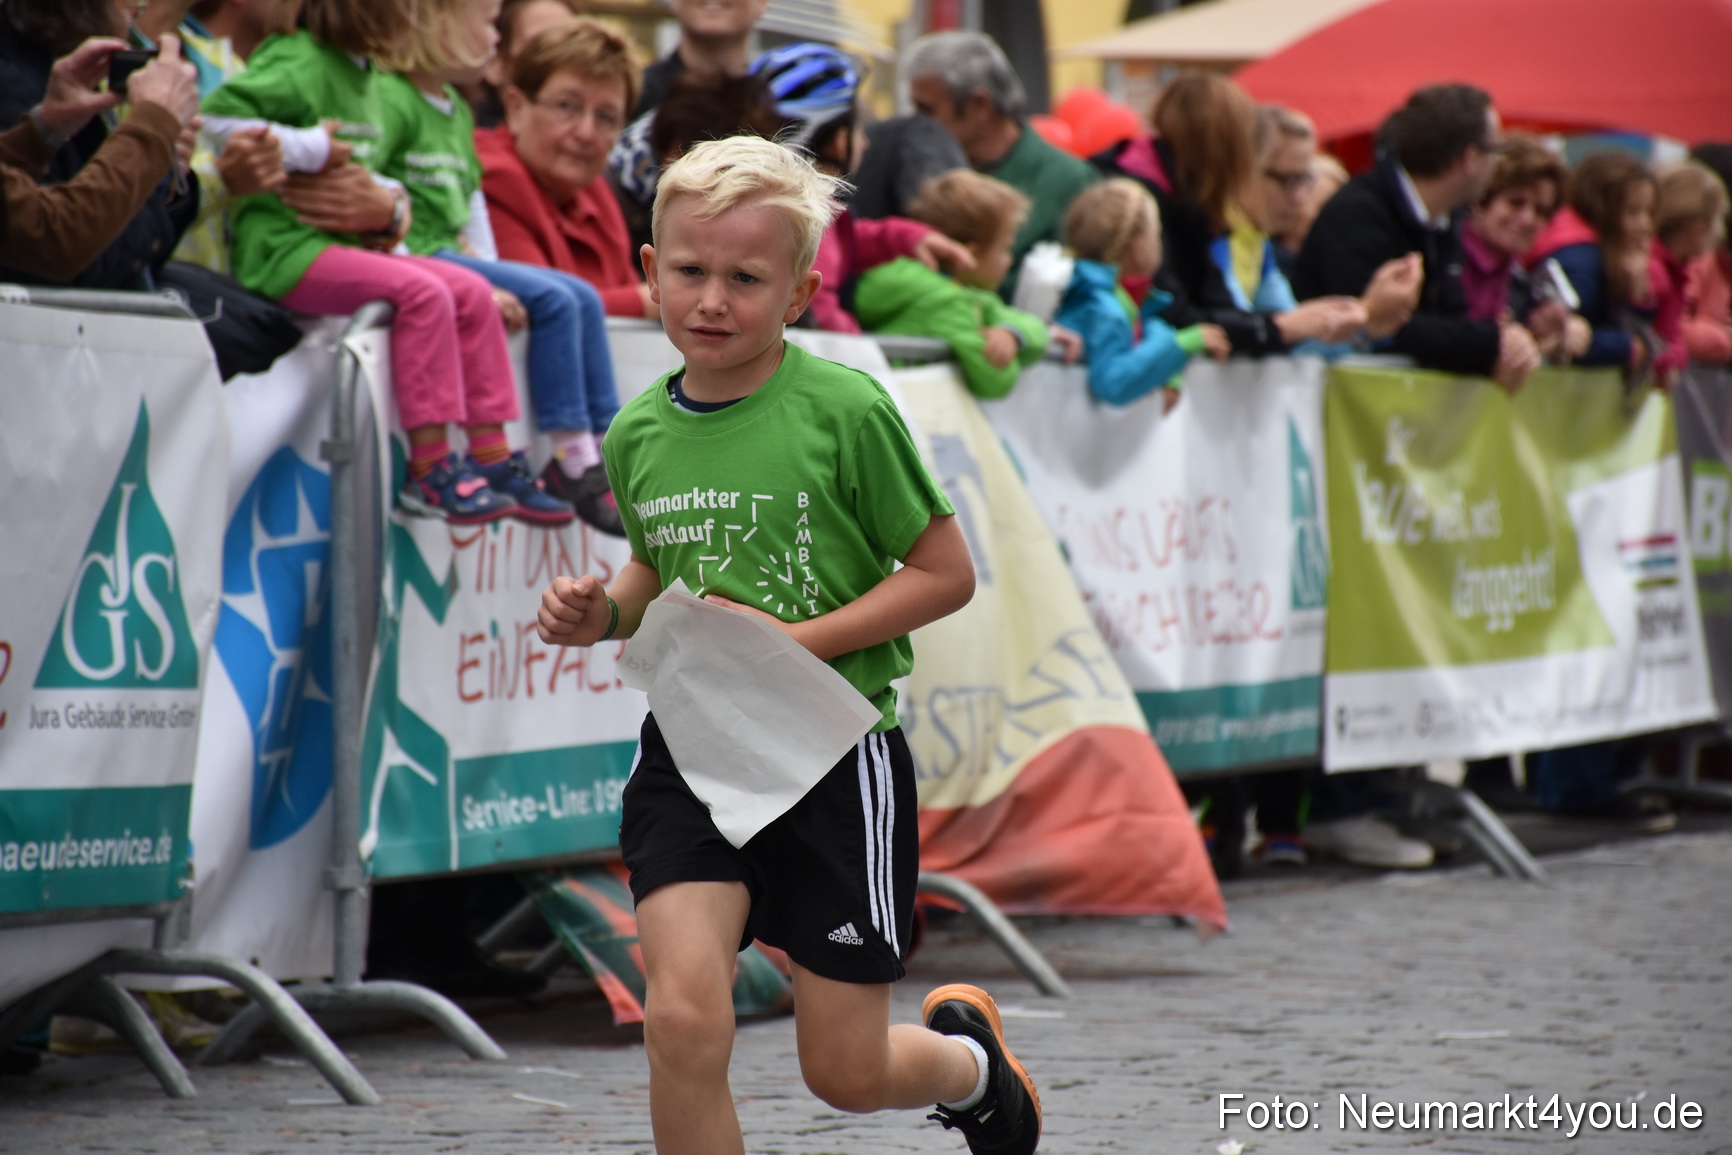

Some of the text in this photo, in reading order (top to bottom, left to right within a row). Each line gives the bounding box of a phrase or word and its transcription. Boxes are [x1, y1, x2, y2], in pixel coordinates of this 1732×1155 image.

[632, 487, 740, 519] Neumarkter
[643, 518, 715, 548] Stadtlauf
[795, 491, 820, 616] BAMBINI
[29, 703, 61, 730] Jura
[64, 703, 126, 729] Gebäude
[127, 703, 168, 729] Service
[0, 828, 173, 872] aeudeservice.de
[827, 932, 864, 946] adidas
